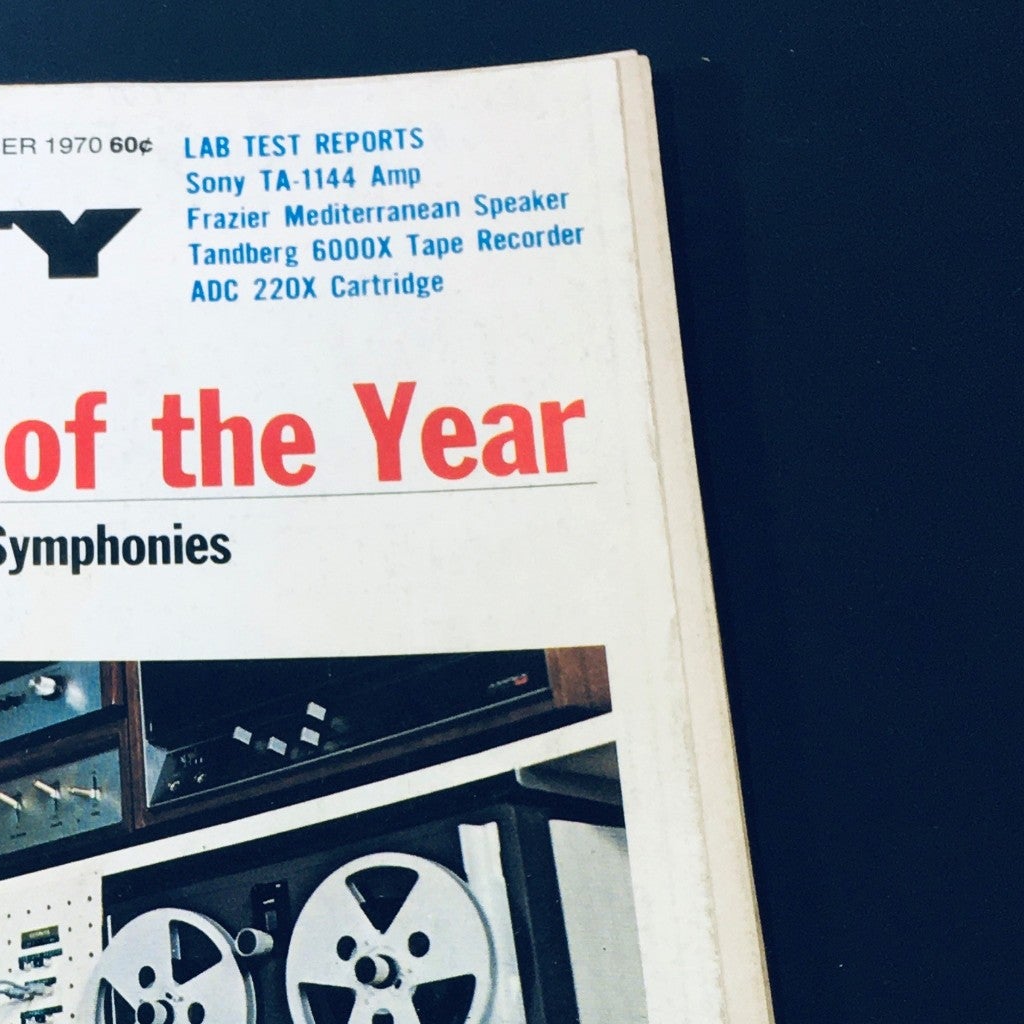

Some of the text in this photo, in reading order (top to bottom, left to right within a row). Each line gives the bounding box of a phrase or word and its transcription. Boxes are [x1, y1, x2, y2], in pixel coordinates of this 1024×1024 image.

[46, 137, 102, 154] 1970
[110, 137, 152, 155] 60¢
[185, 128, 423, 158] LAB TEST REPORTS
[187, 165, 420, 196] Sony TA-1144 Amp
[188, 191, 568, 229] Frazier Mediterranean Speaker
[189, 225, 582, 267] Tandberg 6000X Tape Recorder
[192, 273, 443, 301] ADC 220X Cartridge
[4, 391, 107, 492] of
[152, 389, 316, 488] the
[353, 382, 585, 481] Year
